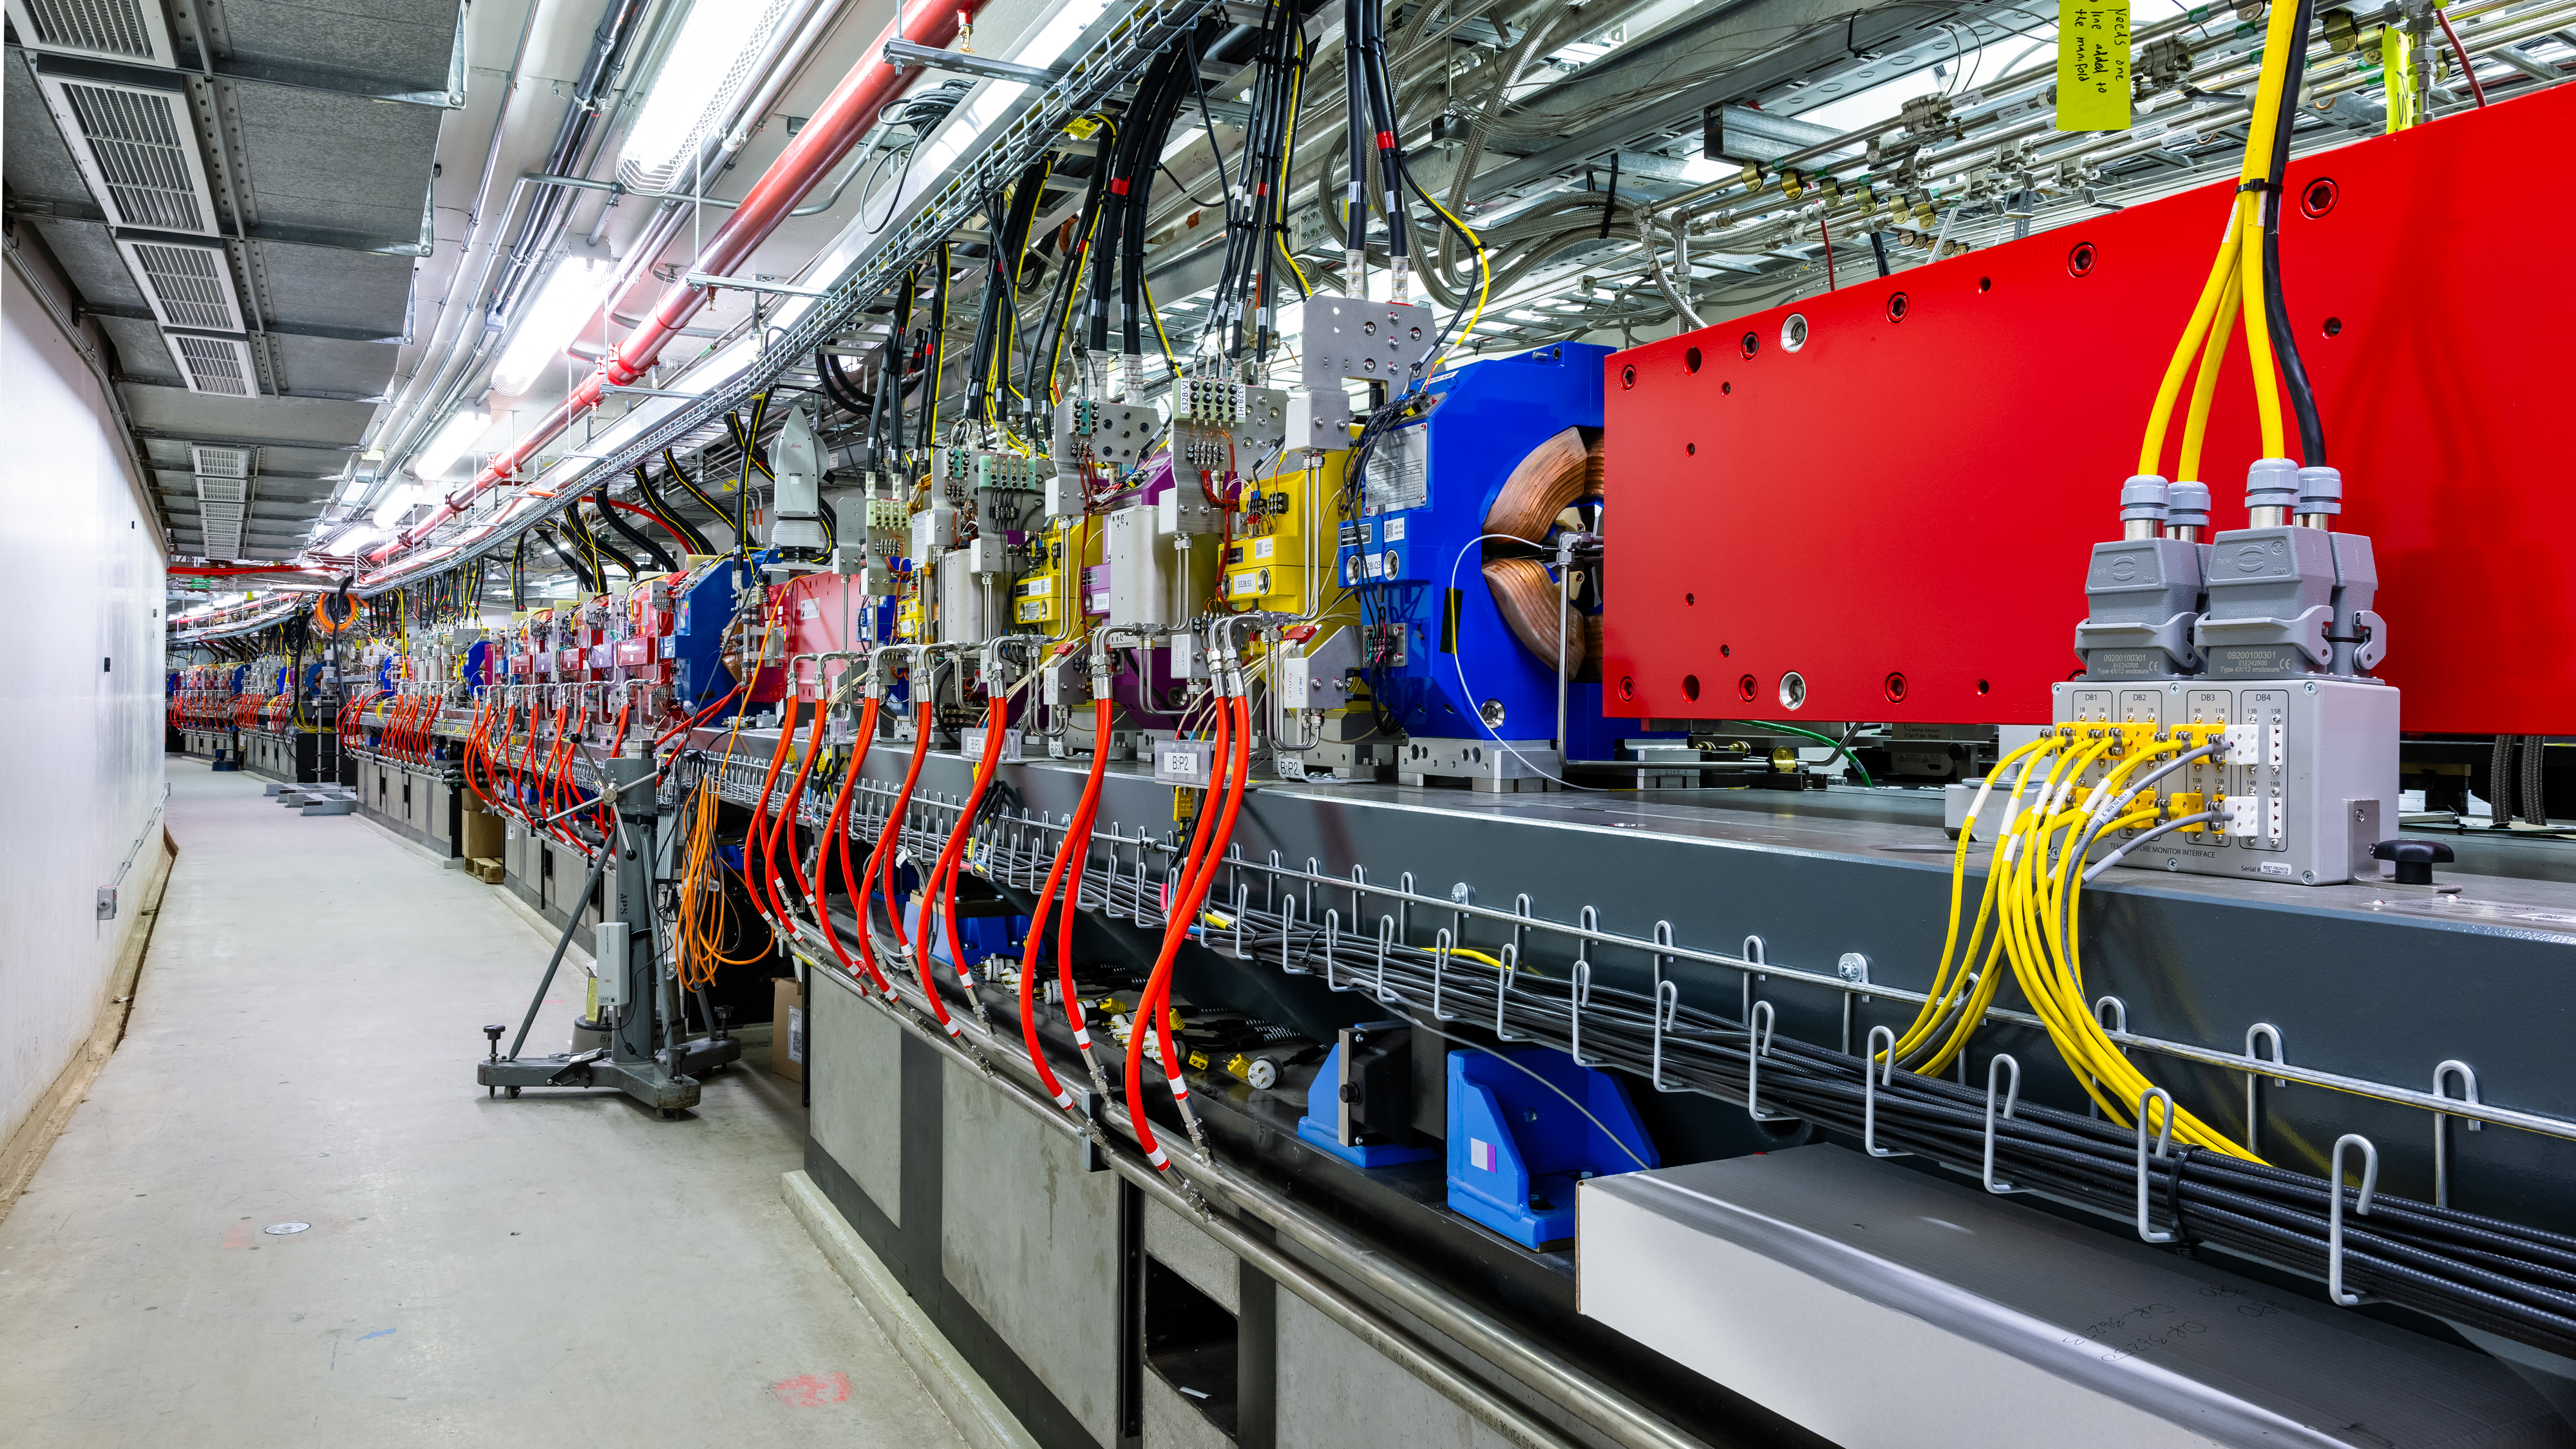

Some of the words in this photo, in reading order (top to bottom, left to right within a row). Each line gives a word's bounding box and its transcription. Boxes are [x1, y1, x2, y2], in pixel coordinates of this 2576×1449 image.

[2075, 8, 2088, 27] the
[2090, 11, 2105, 30] line
[2107, 8, 2128, 46] Needs
[2074, 37, 2090, 82] manifold
[2092, 44, 2109, 74] added
[2115, 60, 2125, 82] one
[2096, 82, 2107, 93] to
[2227, 651, 2276, 659] 09200100301
[1172, 755, 1189, 771] B:P2
[1280, 761, 1300, 776] B:P2
[2117, 792, 2128, 802] 13B
[2152, 846, 2182, 855] MONITOR
[2182, 848, 2215, 858] INTERFACE
